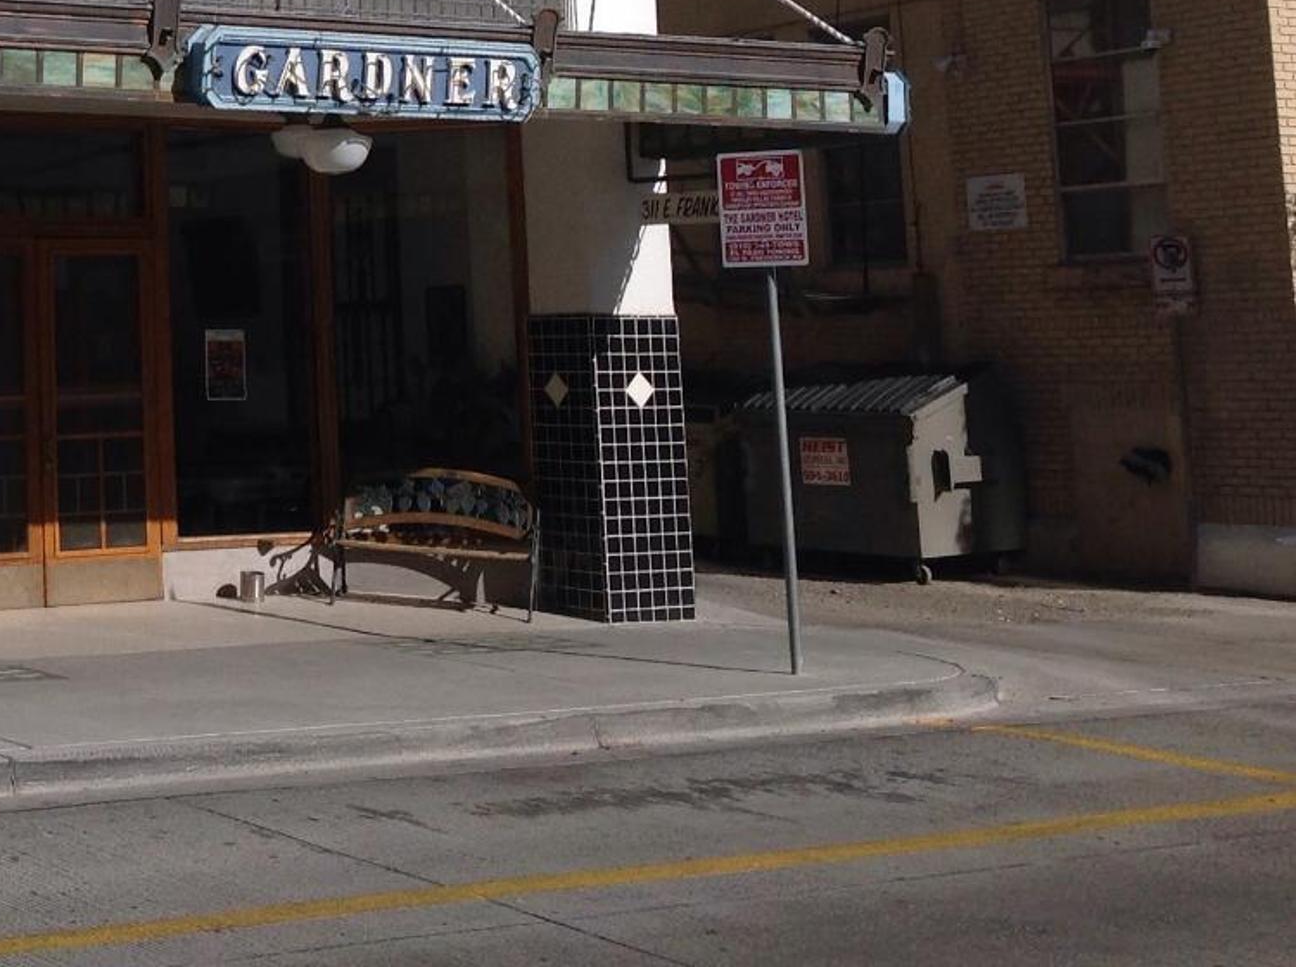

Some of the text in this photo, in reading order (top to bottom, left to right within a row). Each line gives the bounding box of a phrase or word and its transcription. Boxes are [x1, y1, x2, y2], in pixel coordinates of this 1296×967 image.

[234, 44, 518, 109] GARDNER
[727, 223, 800, 233] PARKING ONLY
